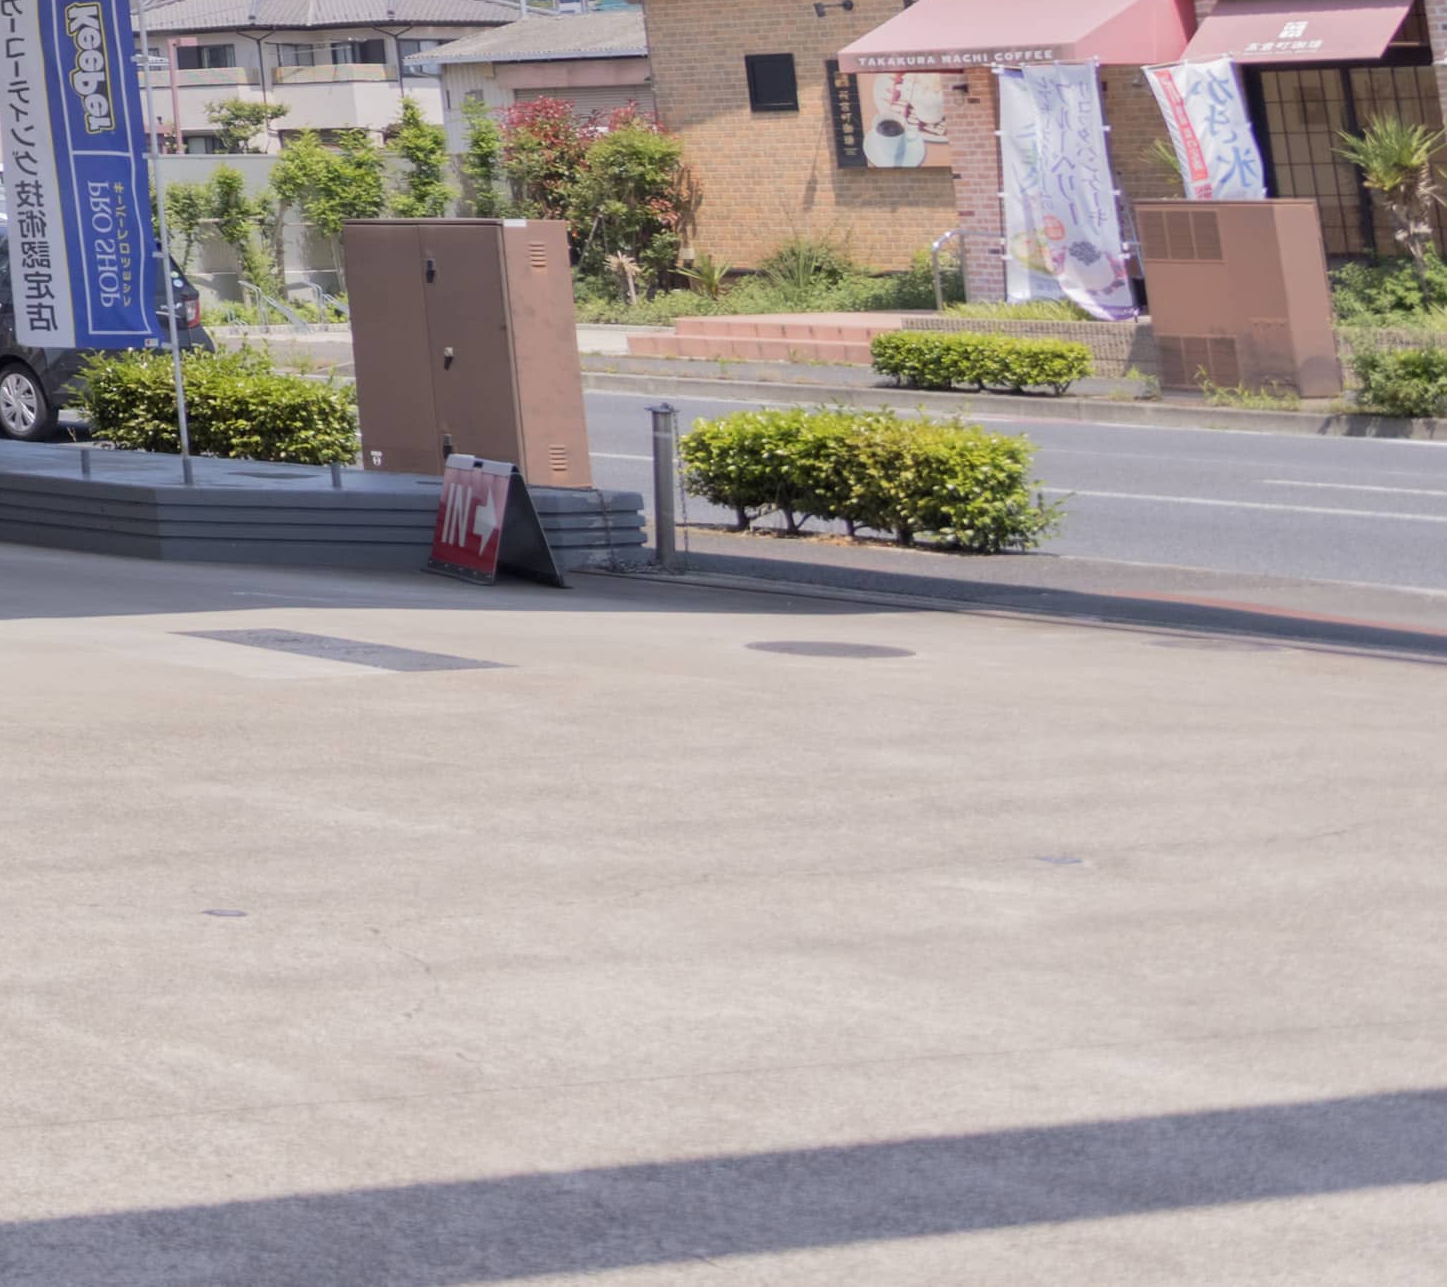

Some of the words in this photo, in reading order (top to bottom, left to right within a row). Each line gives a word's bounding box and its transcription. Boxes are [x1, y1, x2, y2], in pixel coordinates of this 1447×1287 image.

[857, 56, 935, 66] TAKAKURA
[941, 53, 988, 64] MACHI
[993, 49, 1053, 62] COFFEE
[441, 482, 473, 547] IN
